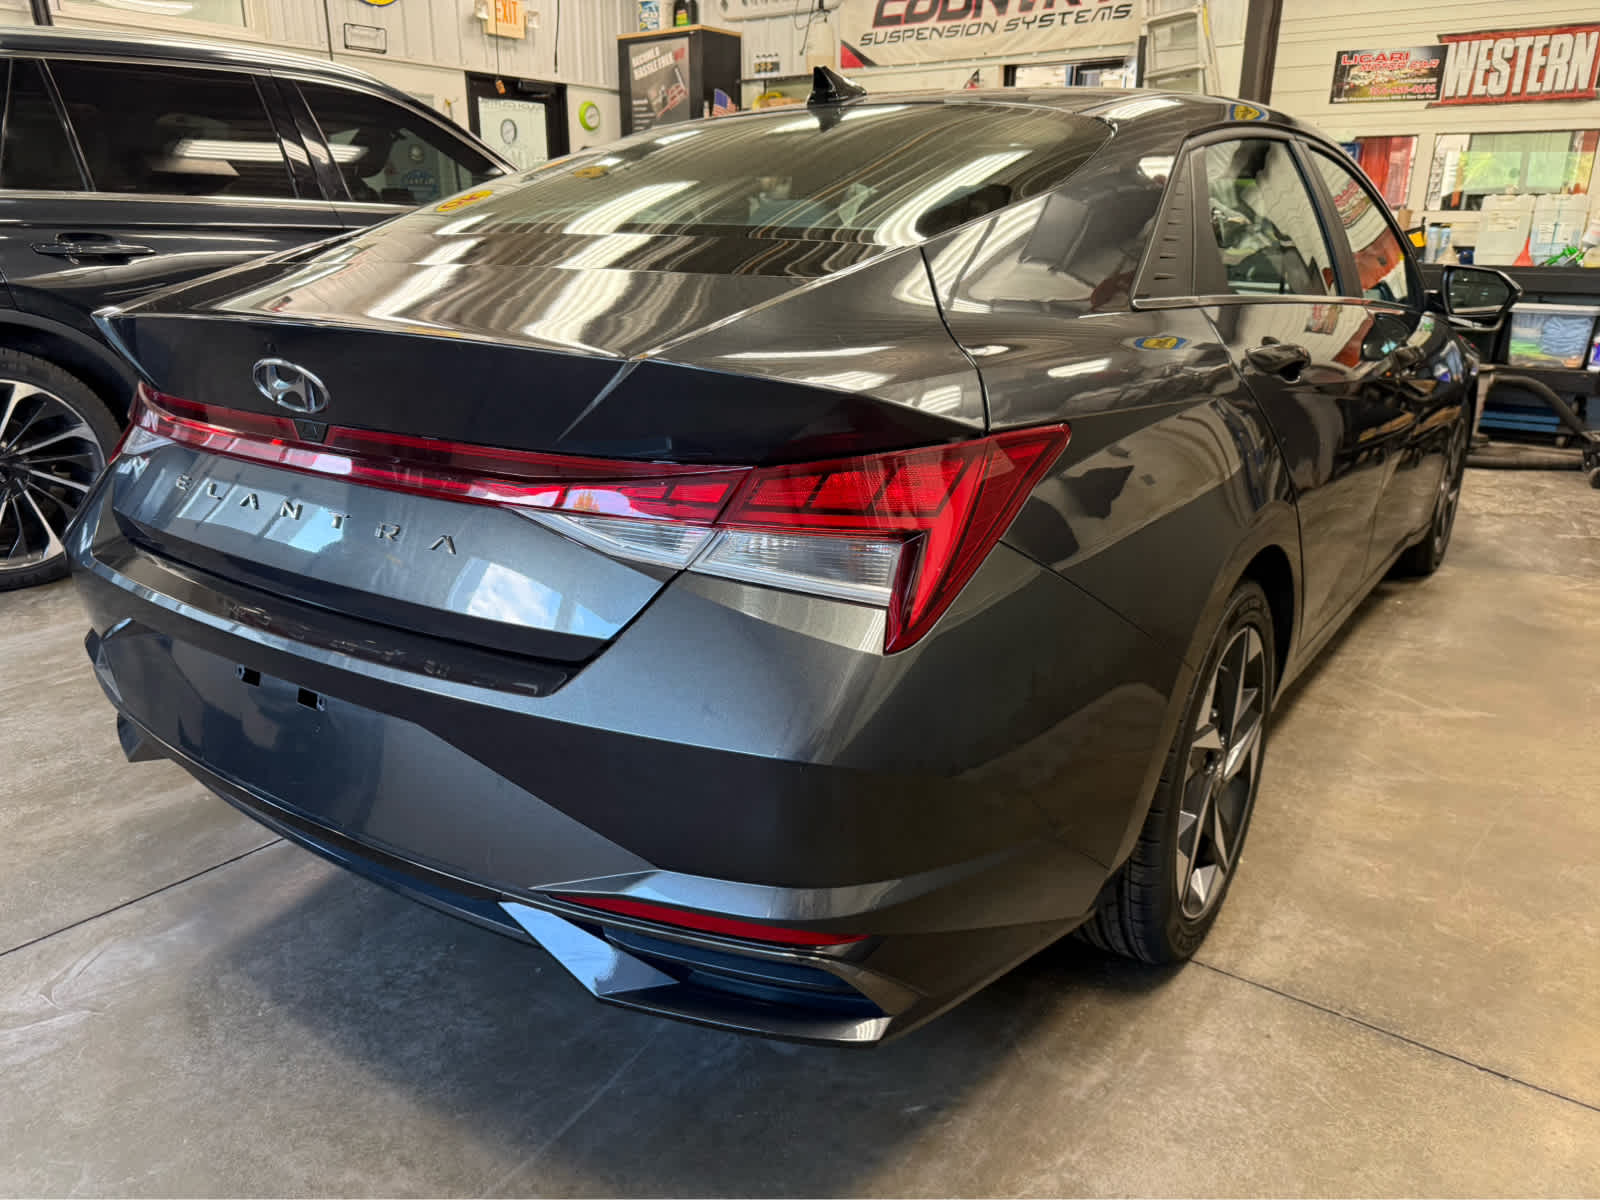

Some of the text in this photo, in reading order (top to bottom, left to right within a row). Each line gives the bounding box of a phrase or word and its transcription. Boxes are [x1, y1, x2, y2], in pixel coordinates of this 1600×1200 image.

[495, 0, 519, 24] EXIT
[859, 3, 1133, 47] SUSPENSION SYSTEMS
[872, 0, 1107, 29] COUN
[1443, 31, 1599, 98] WESTERN
[175, 473, 457, 555] ELANTRA
